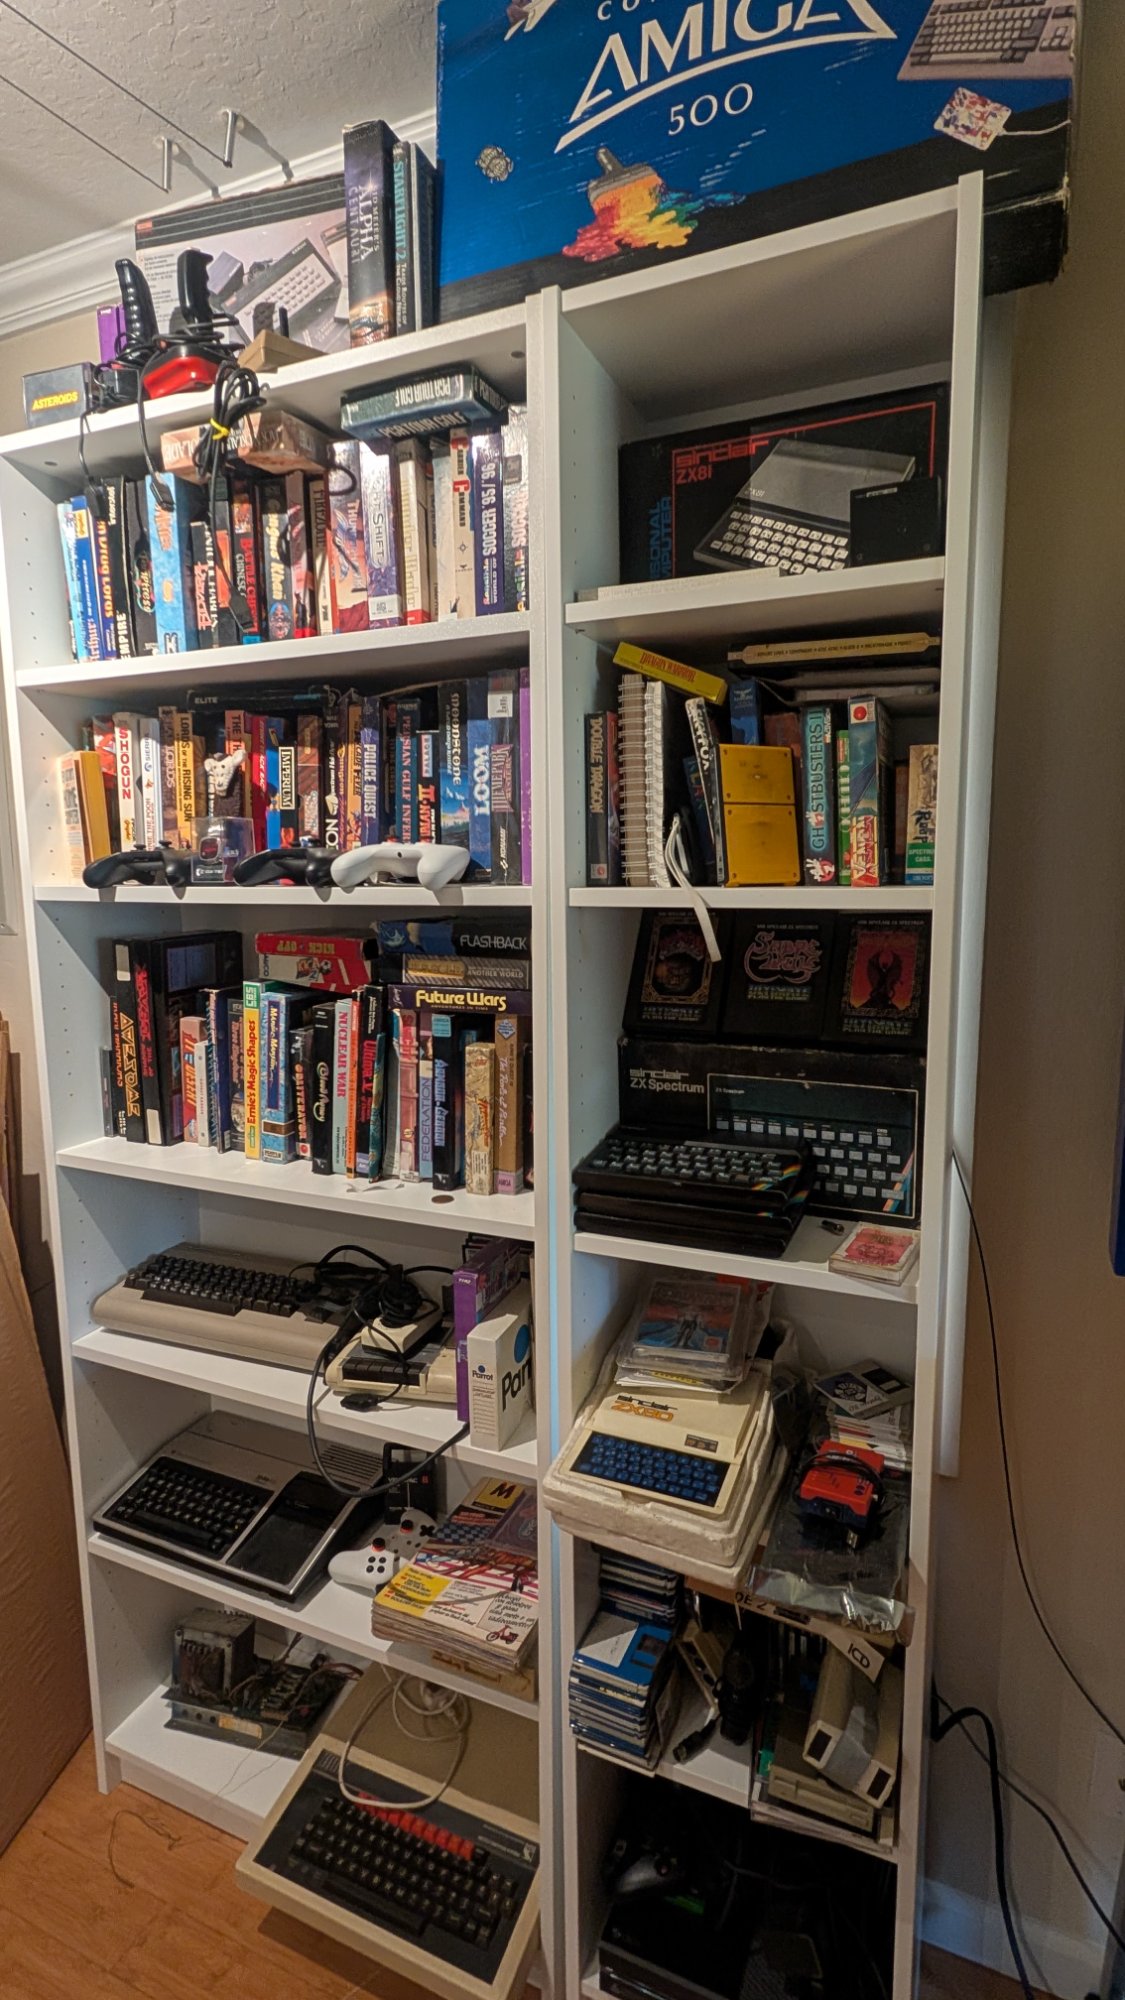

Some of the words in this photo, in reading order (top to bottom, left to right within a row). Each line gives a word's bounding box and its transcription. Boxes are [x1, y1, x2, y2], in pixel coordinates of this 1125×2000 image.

[569, 0, 897, 123] AMIGA
[667, 82, 757, 137] 500
[393, 160, 406, 248] STARFLIGHT
[358, 185, 374, 261] ALPHA
[395, 250, 406, 262] 2
[32, 391, 79, 411] ASTEROIDS
[676, 440, 769, 468] sinclair
[676, 464, 712, 485] ZX81
[371, 512, 385, 558] SHIFT
[481, 509, 497, 557] SOCCER
[239, 538, 255, 585] BATTLE
[270, 562, 285, 601] Khan
[194, 696, 219, 704] ELITE
[180, 716, 192, 749] LORDS
[231, 714, 242, 735] THE
[401, 715, 412, 766] PERSIAN
[590, 716, 604, 762] DOUBLE
[118, 726, 132, 800] SHOGUN
[281, 750, 292, 807] IMPERIUM
[364, 743, 377, 782] POLICE
[472, 744, 490, 816] LOOM
[183, 769, 192, 801] RISING
[364, 784, 377, 819] QUEST
[402, 770, 412, 801] GULF
[590, 765, 604, 814] DRAGON
[183, 803, 193, 822] SUN
[401, 804, 412, 844] INFER
[908, 848, 935, 856] SPECTRU
[460, 934, 528, 951] FLASHBACK
[245, 986, 254, 1008] CBS
[415, 989, 464, 1007] Future
[466, 991, 507, 1012] Wars
[246, 1020, 258, 1058] Shapes
[336, 1010, 349, 1070] NUCLEAR
[119, 1012, 141, 1117] AWESOME
[246, 1059, 258, 1092] Magic
[362, 1039, 377, 1077] Ultima
[629, 1067, 689, 1079] sinclair
[336, 1071, 348, 1098] WAR
[630, 1077, 647, 1090] ZX
[648, 1079, 705, 1094] Spectrum
[247, 1093, 257, 1125] Ernie's
[421, 1077, 431, 1163] FEDERATION
[472, 1370, 493, 1382] Parrot
[610, 1401, 674, 1422] ZX80
